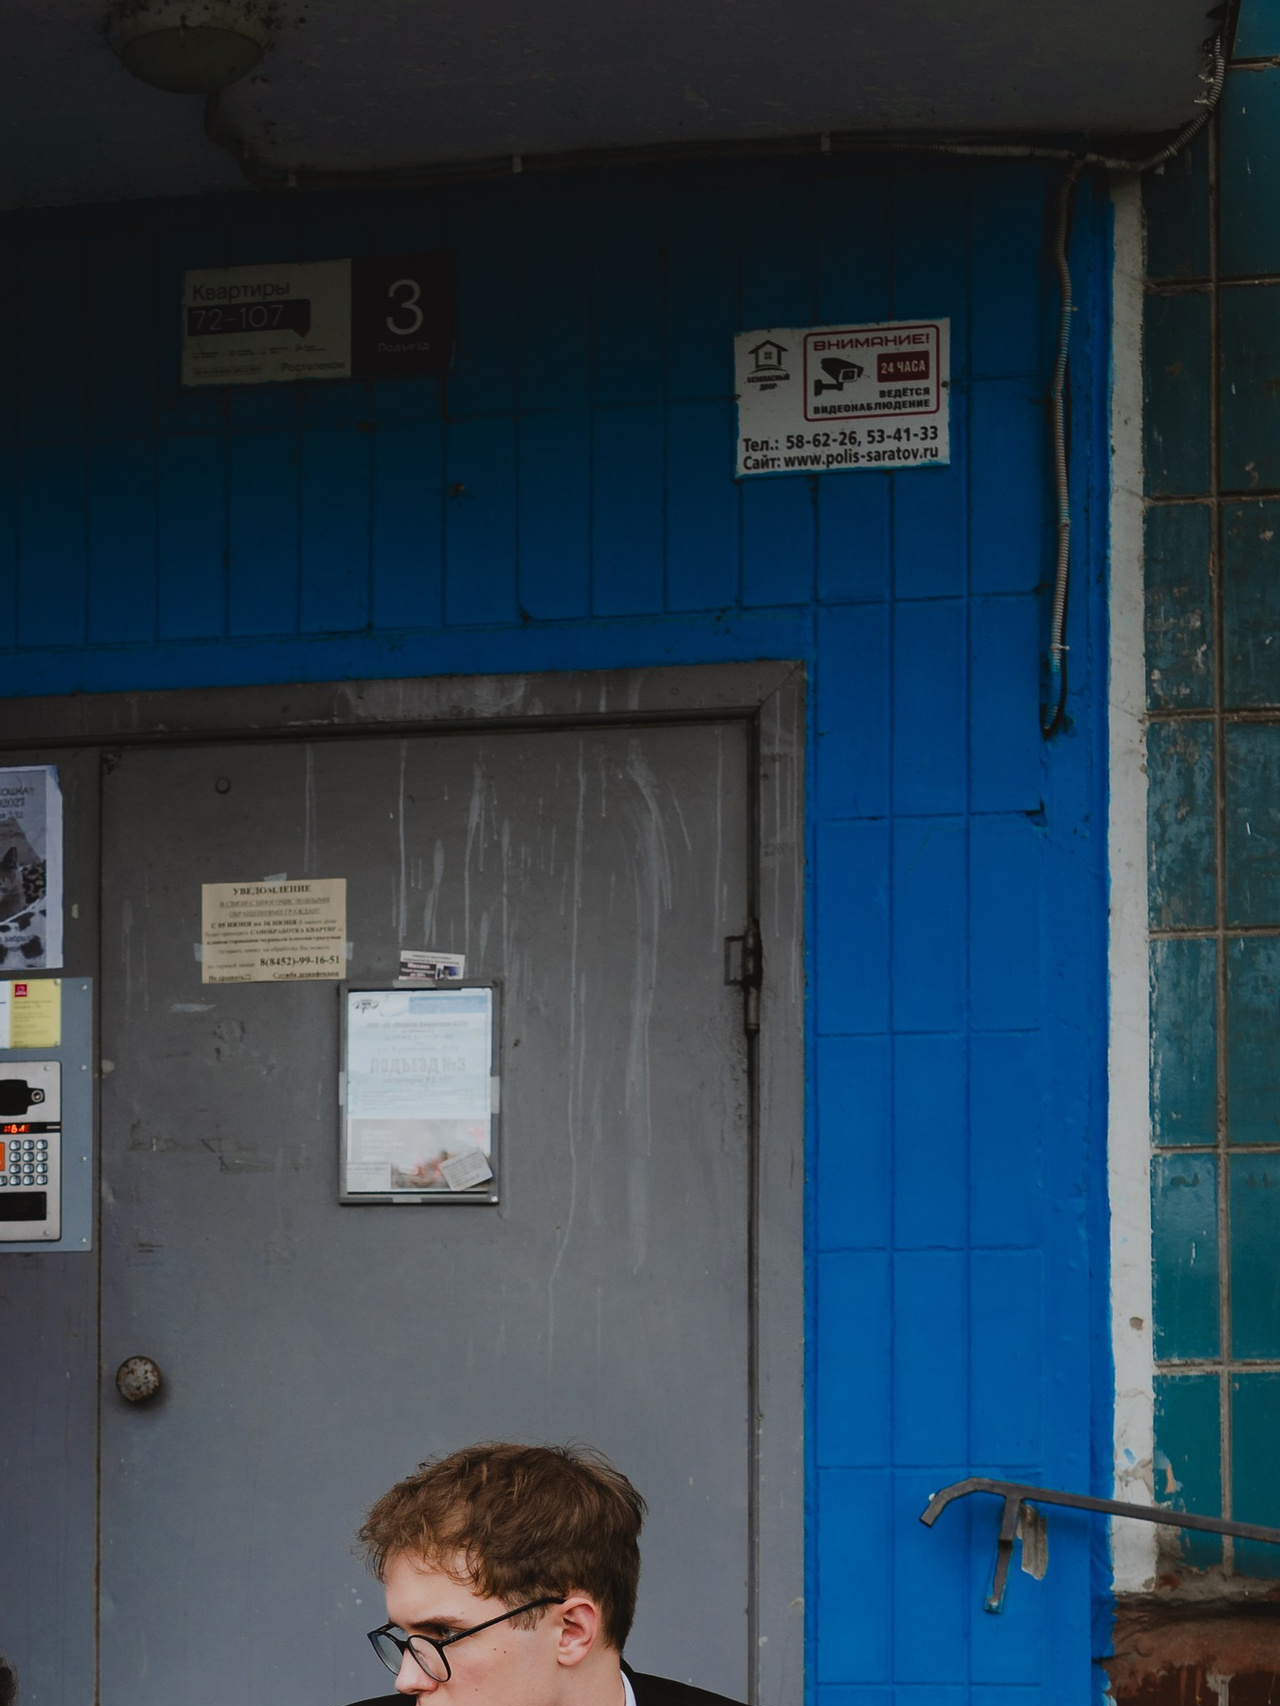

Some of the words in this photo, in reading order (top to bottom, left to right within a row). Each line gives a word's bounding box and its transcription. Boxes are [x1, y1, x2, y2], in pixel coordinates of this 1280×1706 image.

[192, 282, 290, 303] Квартиры
[386, 279, 424, 335] 3
[193, 304, 284, 331] 72-107
[377, 342, 430, 353] Подъезд
[813, 333, 930, 351] ВНИМАНИЕ!
[280, 361, 345, 373] Ростелеком
[880, 362, 894, 375] 24
[896, 360, 926, 374] ЧАСА
[747, 373, 790, 384] БЕЗОПАСНЫЙ
[759, 383, 778, 392] ДВОР
[879, 386, 930, 399] ВЕДЁТСЯ
[813, 399, 931, 415] ВИДЕОНАБЛЮДЕНИЕ
[743, 437, 779, 453] Тел.:
[786, 431, 862, 450] 58-62-26,
[867, 426, 939, 444] 53-41-33
[743, 454, 781, 470] Сайт:
[784, 446, 939, 467] www.polis-saratov.ru
[232, 885, 312, 896] УВЕДОМЛЕНИЕ
[259, 955, 340, 967] 8(8452)-99-16-51
[370, 1057, 439, 1075] ПОДЪЕЗД
